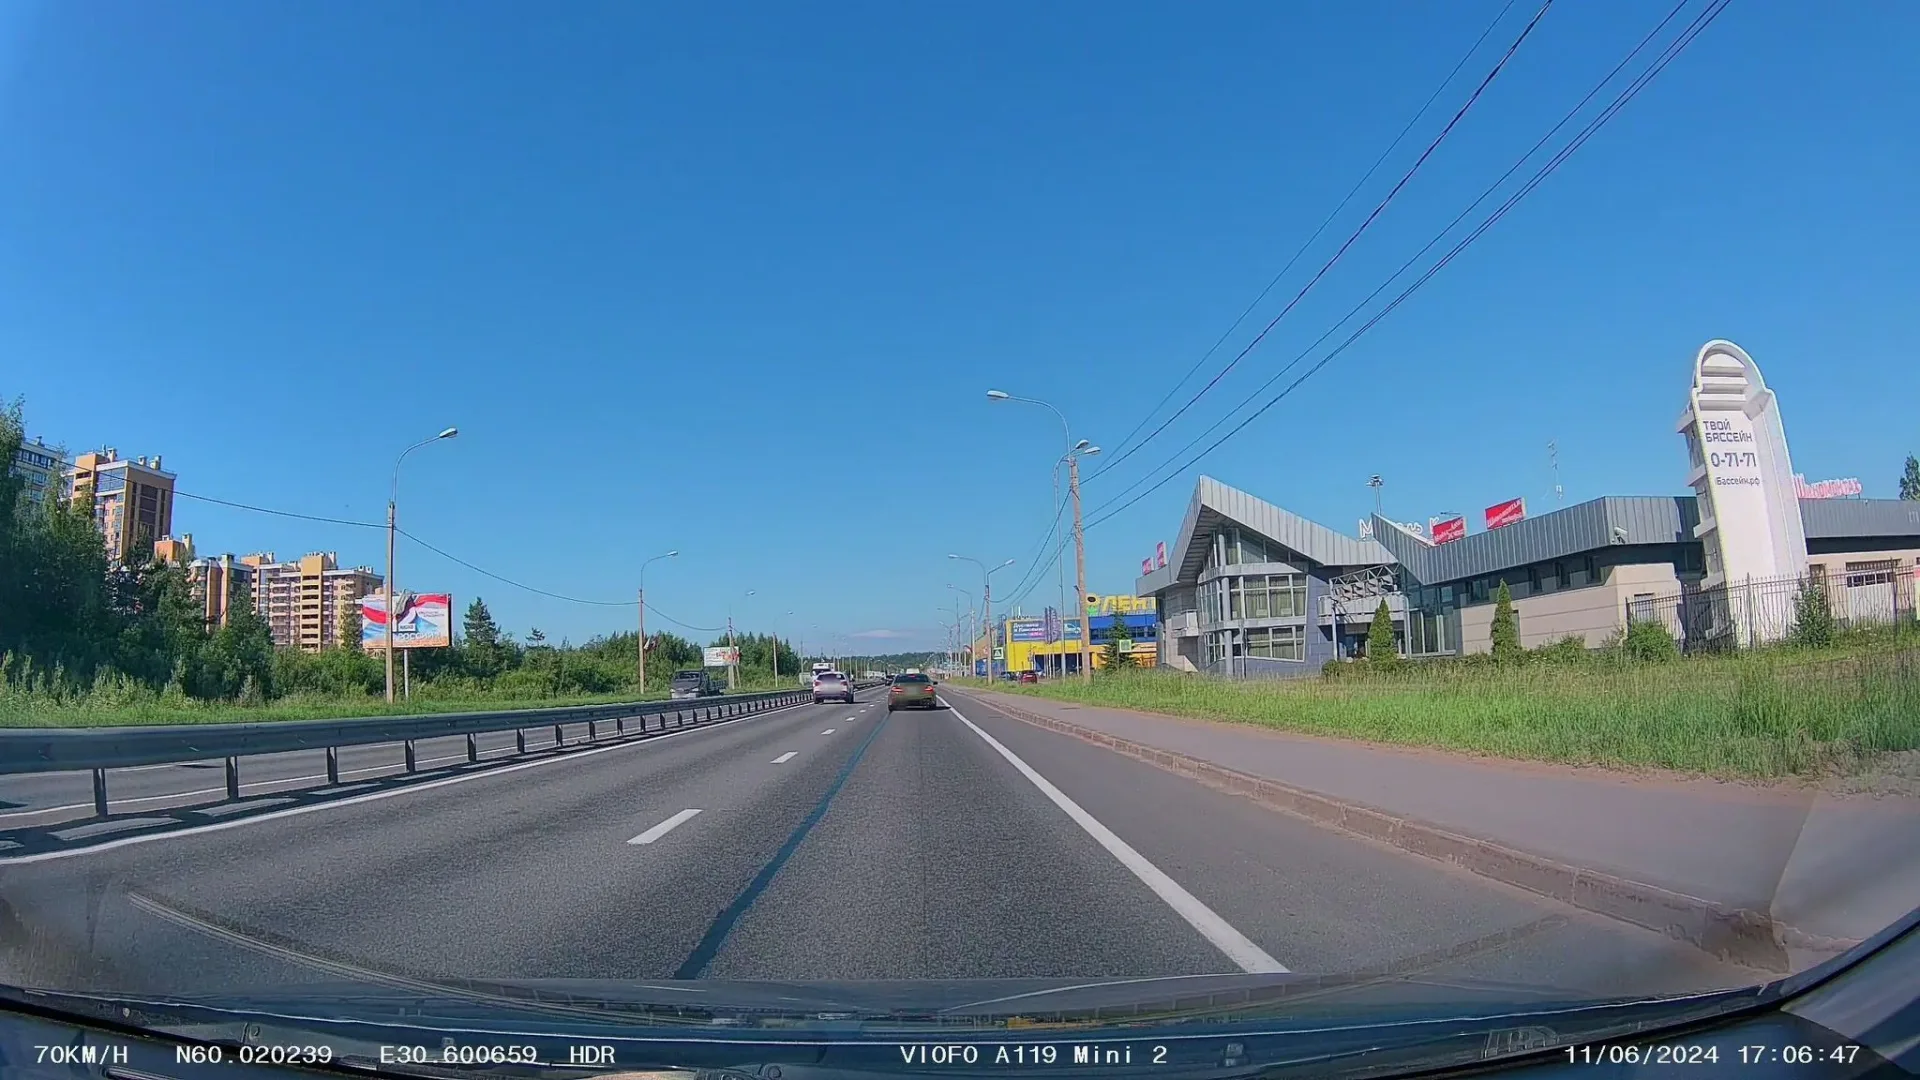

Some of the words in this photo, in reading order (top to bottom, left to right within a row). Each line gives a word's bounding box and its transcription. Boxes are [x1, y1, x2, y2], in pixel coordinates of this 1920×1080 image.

[1703, 418, 1731, 430] ТВОЙ
[1705, 430, 1752, 442] БАССЕЙН
[1711, 452, 1756, 467] 0-71-71
[1102, 595, 1156, 613] ЛЕН
